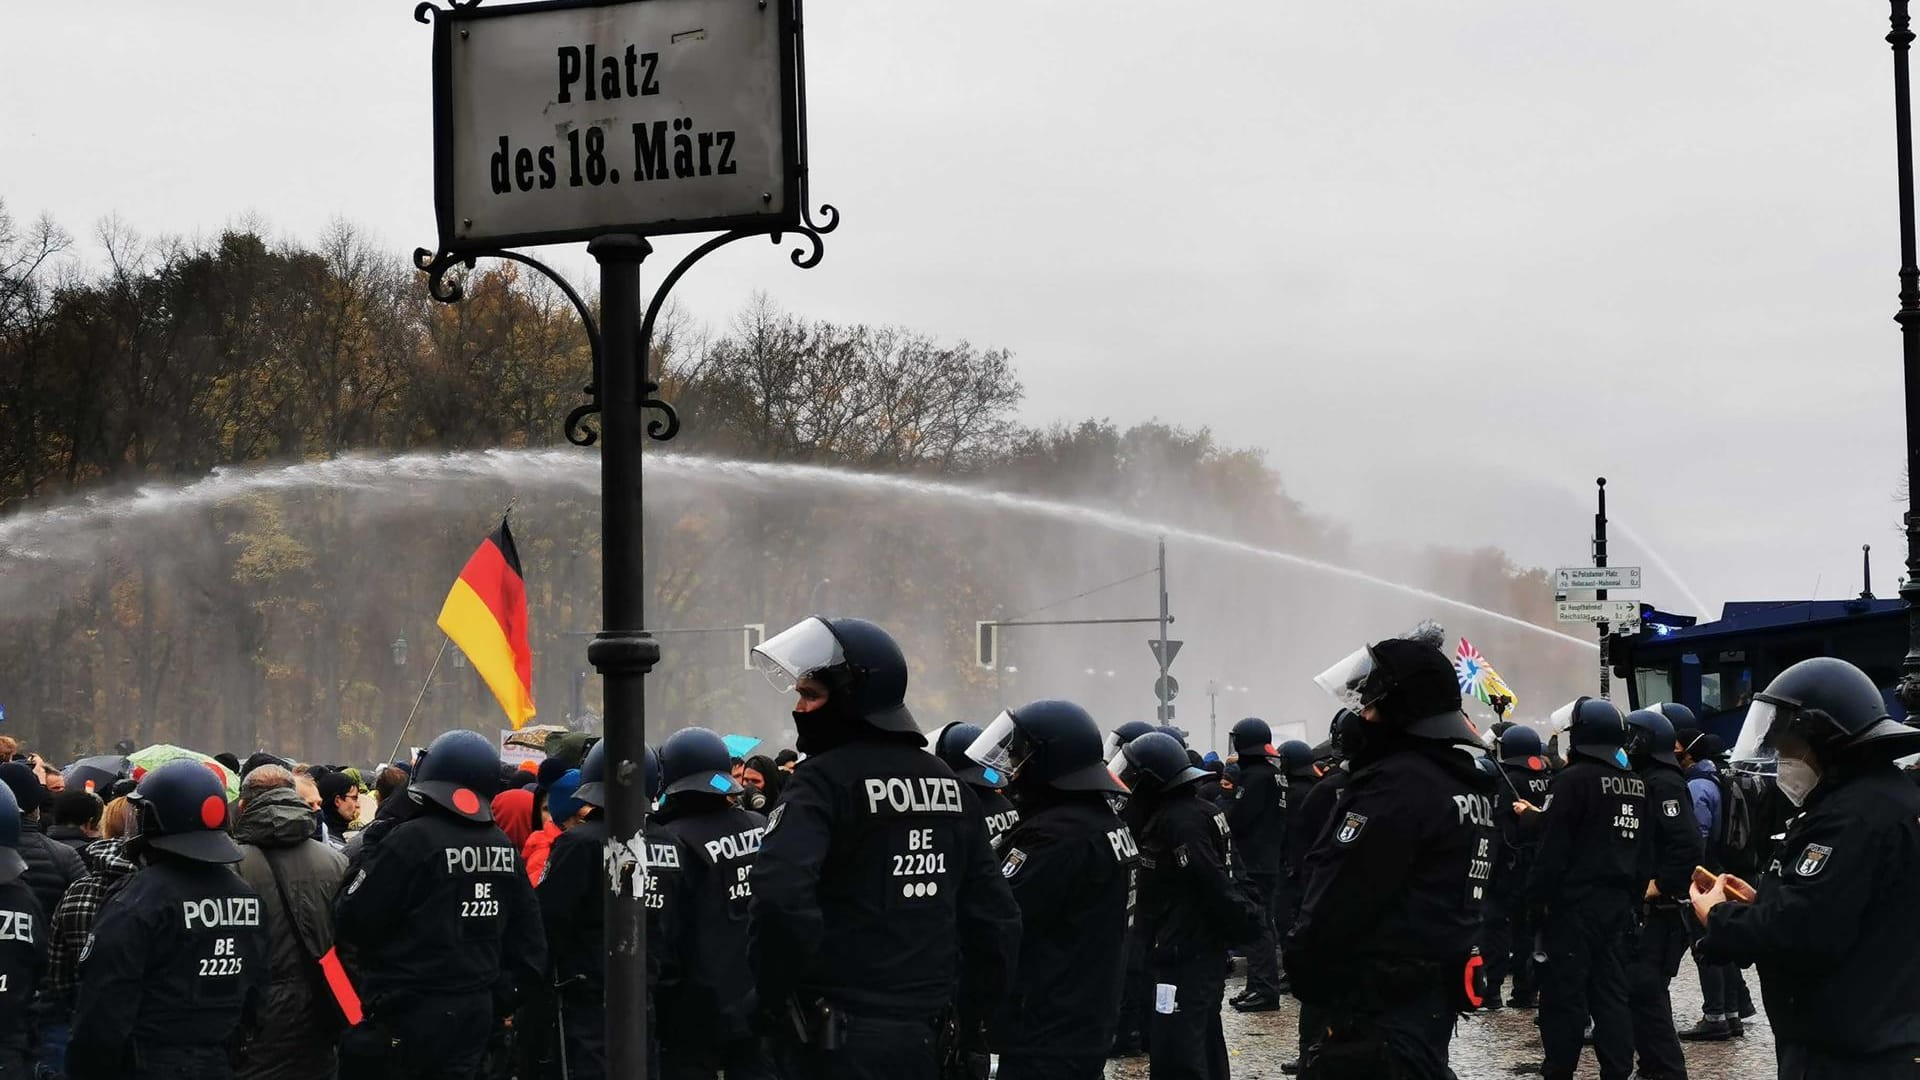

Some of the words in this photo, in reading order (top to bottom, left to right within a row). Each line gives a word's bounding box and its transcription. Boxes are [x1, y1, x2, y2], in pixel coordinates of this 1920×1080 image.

[557, 43, 660, 103] Platz
[490, 135, 557, 195] des
[567, 126, 620, 188] 18.
[632, 117, 738, 182] März
[865, 777, 963, 814] POLIZEI
[1600, 776, 1646, 798] POLIZEI
[1621, 803, 1634, 817] BE
[1613, 815, 1640, 830] 14230
[909, 828, 934, 851] BE
[1477, 838, 1489, 858] BE
[445, 846, 515, 874] POLIZEI
[892, 852, 946, 876] 22201
[474, 882, 493, 899] BE
[183, 898, 260, 929] POLIZEI
[461, 900, 499, 917] 22223
[214, 938, 235, 956] BE
[199, 957, 242, 976] 22225
